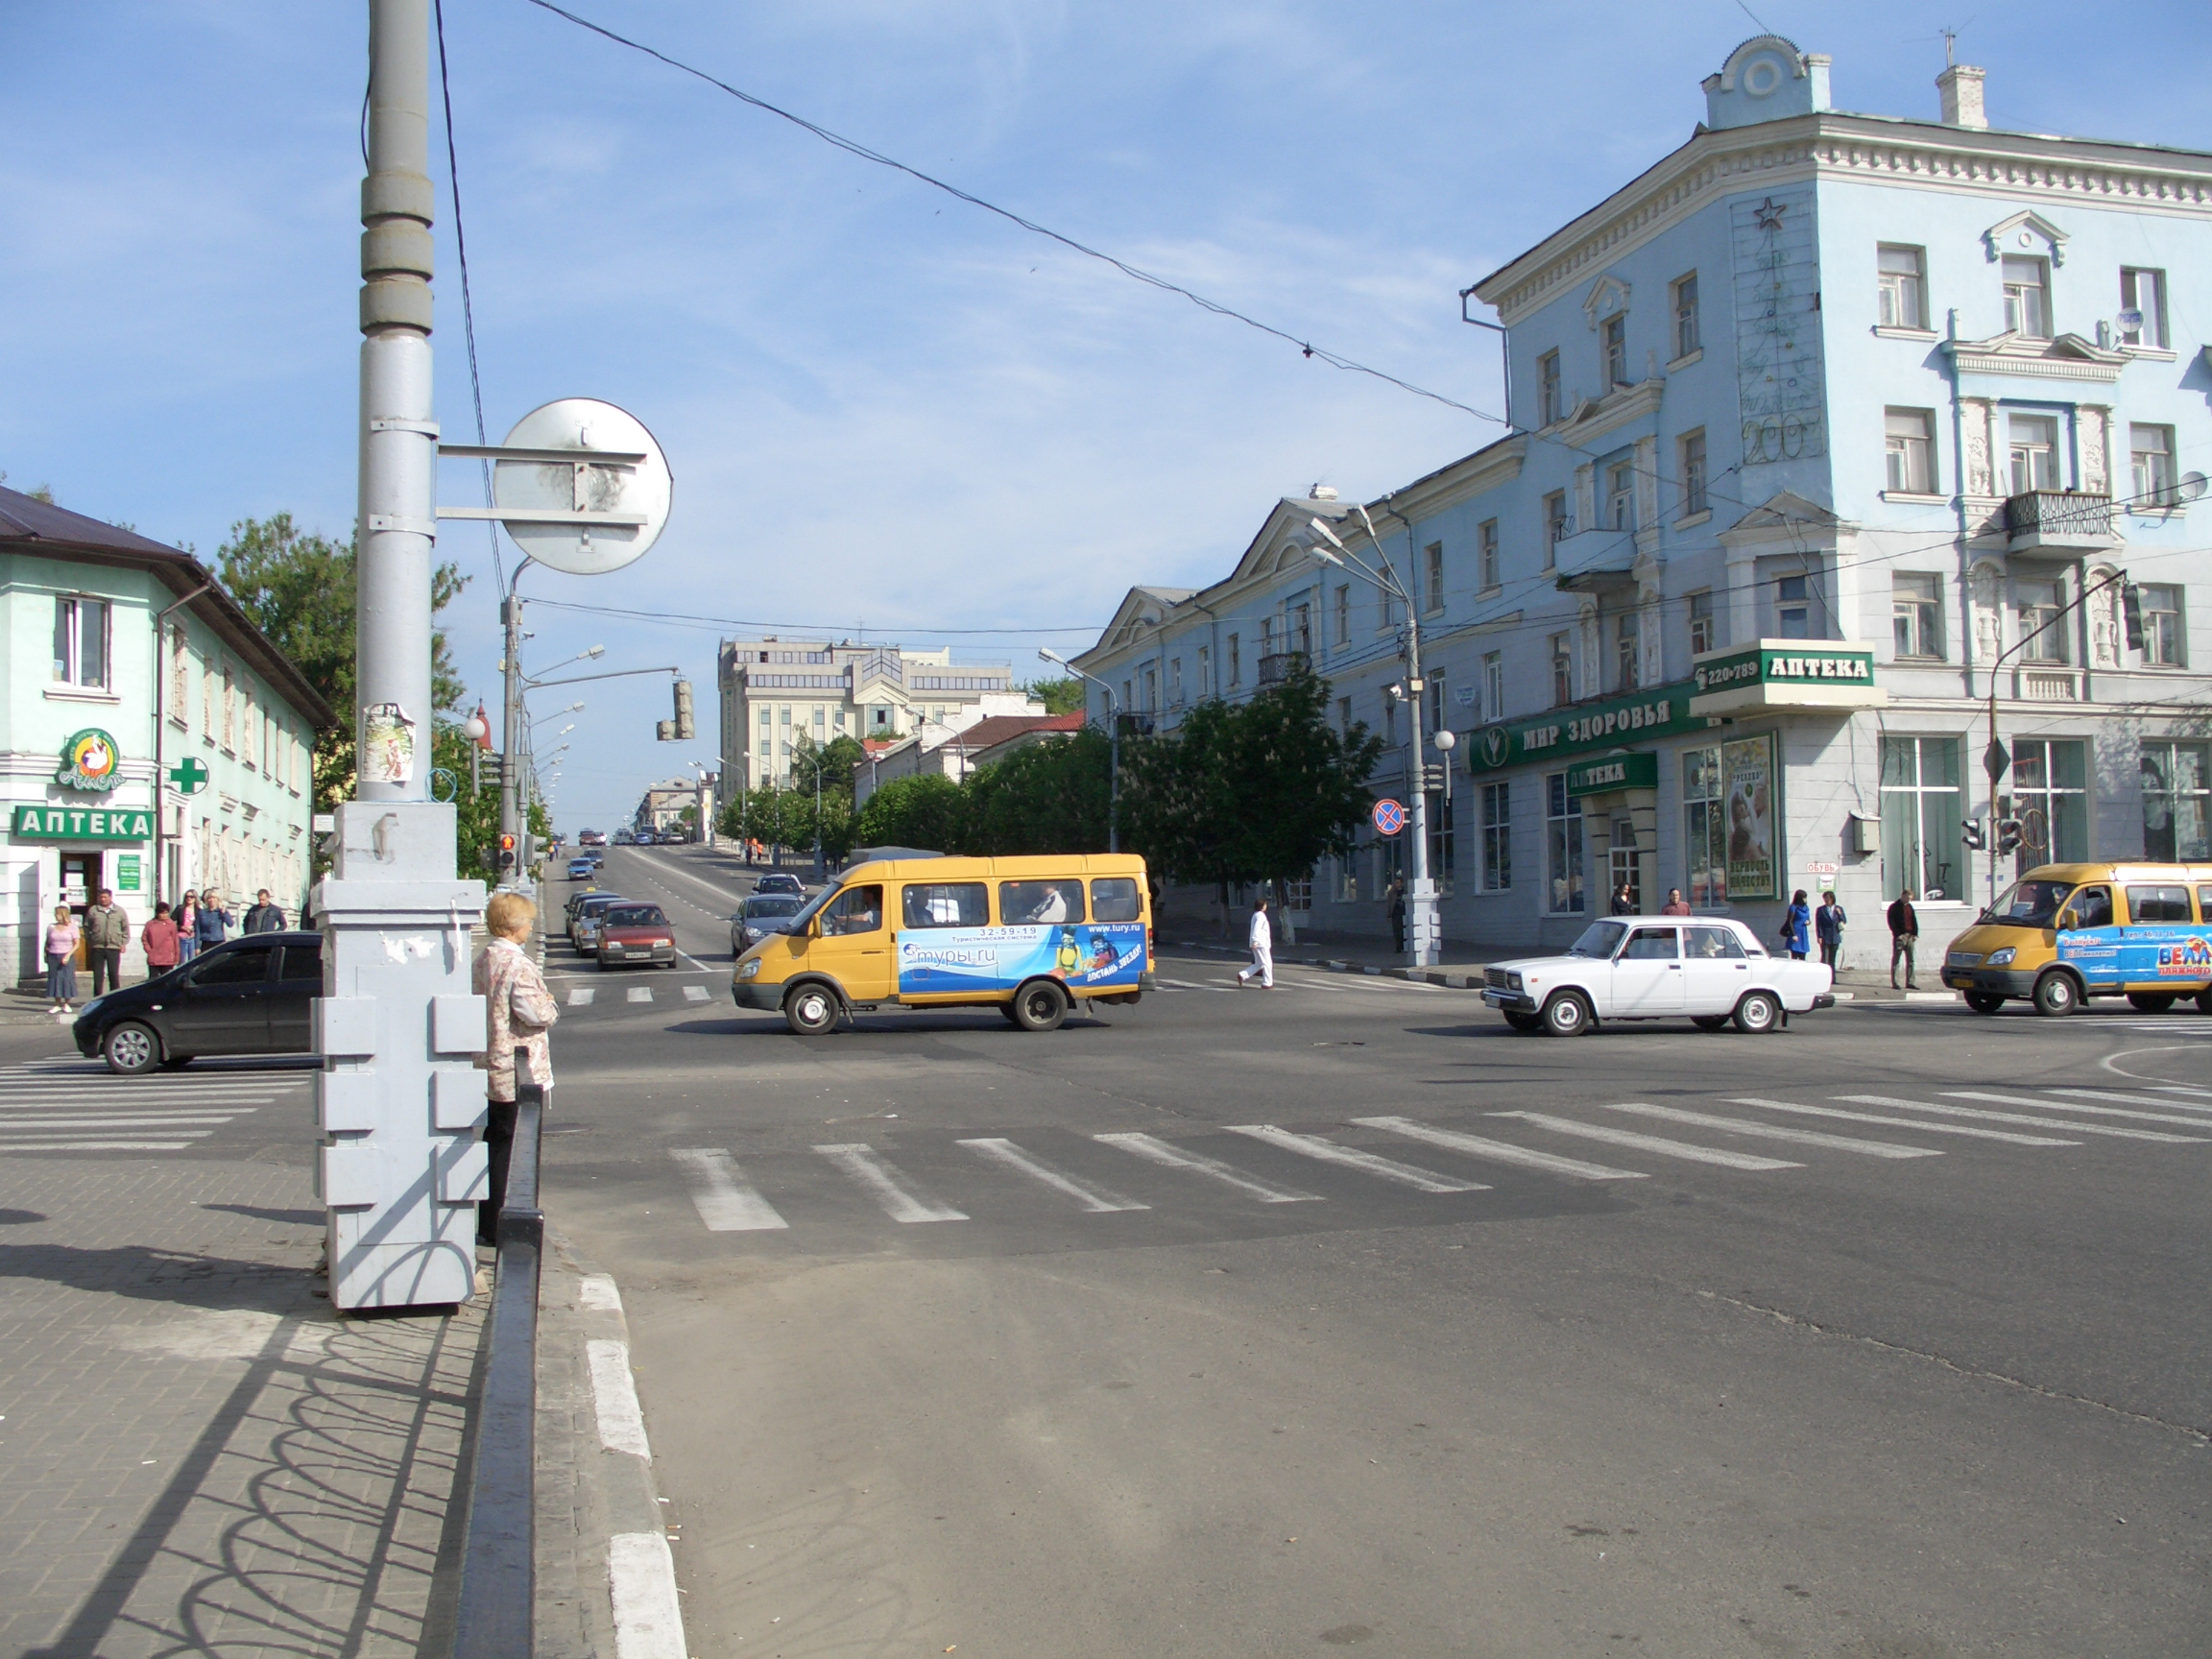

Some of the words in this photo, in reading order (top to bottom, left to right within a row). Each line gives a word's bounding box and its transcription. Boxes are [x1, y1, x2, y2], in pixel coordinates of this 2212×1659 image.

[1769, 658, 1869, 678] АПТЕКА
[1523, 725, 1560, 751] МИР
[1568, 700, 1671, 742] ЗДОРОВЬЯ
[1571, 762, 1626, 787] АПТЕКА
[21, 810, 150, 835] АПТЕКА
[1088, 924, 1141, 933] www.tury.ru
[2158, 966, 2211, 975] ПЛЯЖНОГО
